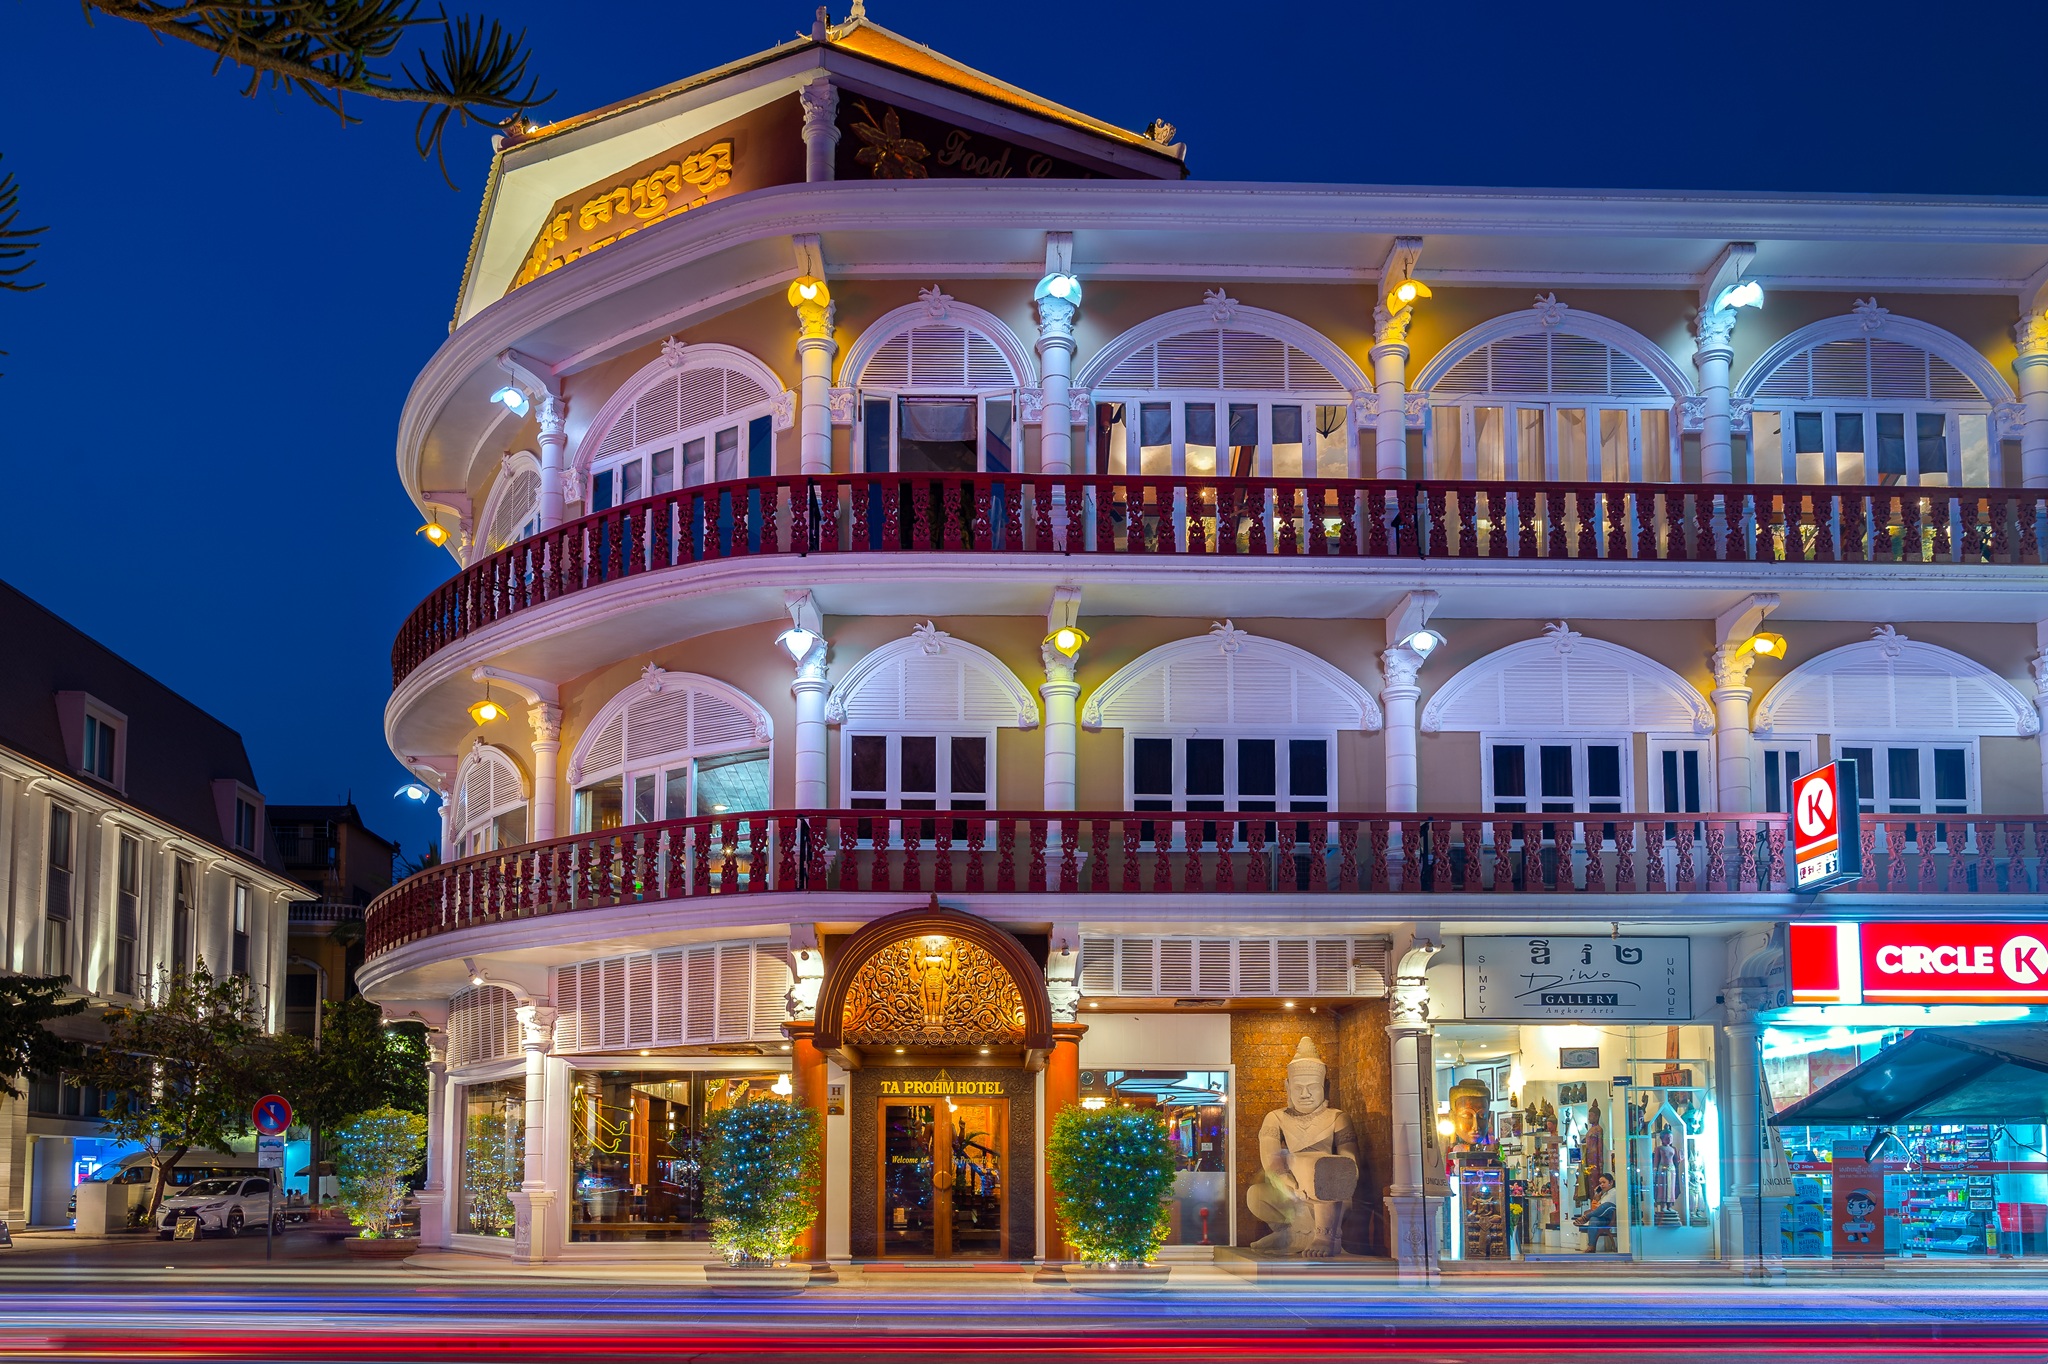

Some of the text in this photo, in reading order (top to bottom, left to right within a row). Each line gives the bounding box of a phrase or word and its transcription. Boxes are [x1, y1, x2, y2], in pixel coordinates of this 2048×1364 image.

[1876, 944, 1994, 974] CIRCLE
[1478, 955, 1488, 1014] SIMPLY
[1666, 957, 1676, 1016] UNIQUE
[1545, 995, 1615, 1004] GALLERY
[1546, 1007, 1584, 1015] Angkor
[881, 1081, 1004, 1095] TA PROHM HOTEL
[892, 1155, 918, 1164] Welcome
